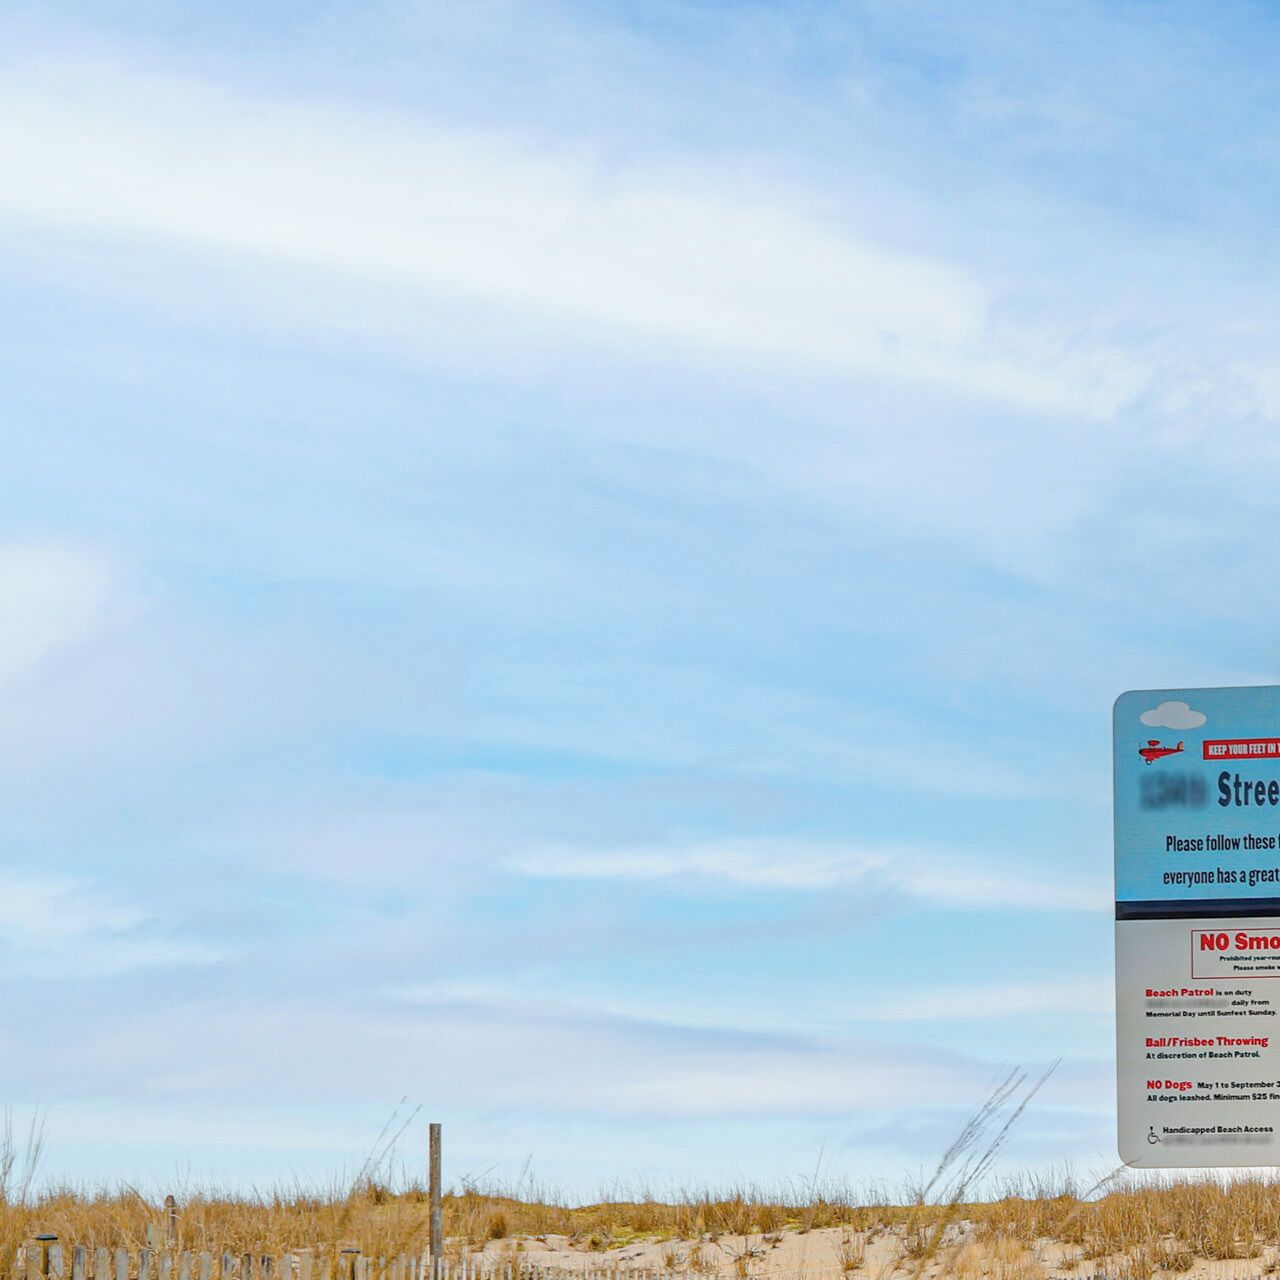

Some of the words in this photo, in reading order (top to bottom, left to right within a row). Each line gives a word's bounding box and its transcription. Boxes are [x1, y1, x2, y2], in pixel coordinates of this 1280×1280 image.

[1208, 744, 1228, 756] KEEP
[1228, 744, 1248, 755] YOUR
[1249, 743, 1266, 754] FEET
[1268, 743, 1276, 754] IN
[1166, 835, 1204, 852] Please
[1206, 834, 1241, 851] follow
[1242, 834, 1276, 850] these
[1163, 871, 1215, 888] everyone
[1216, 866, 1238, 884] has
[1240, 870, 1246, 883] a
[1248, 868, 1280, 886] great
[1200, 932, 1230, 951] NO
[1145, 988, 1178, 997] Beach
[1181, 988, 1214, 997] Patrol
[1146, 1037, 1214, 1048] Ball/Frisbee
[1216, 1036, 1269, 1048] Throwing
[1147, 1080, 1162, 1089] NO
[1165, 1080, 1193, 1091] Dogs
[1231, 1081, 1274, 1090] September
[1159, 1094, 1177, 1103] dogs
[1163, 1126, 1216, 1135] Handicapped
